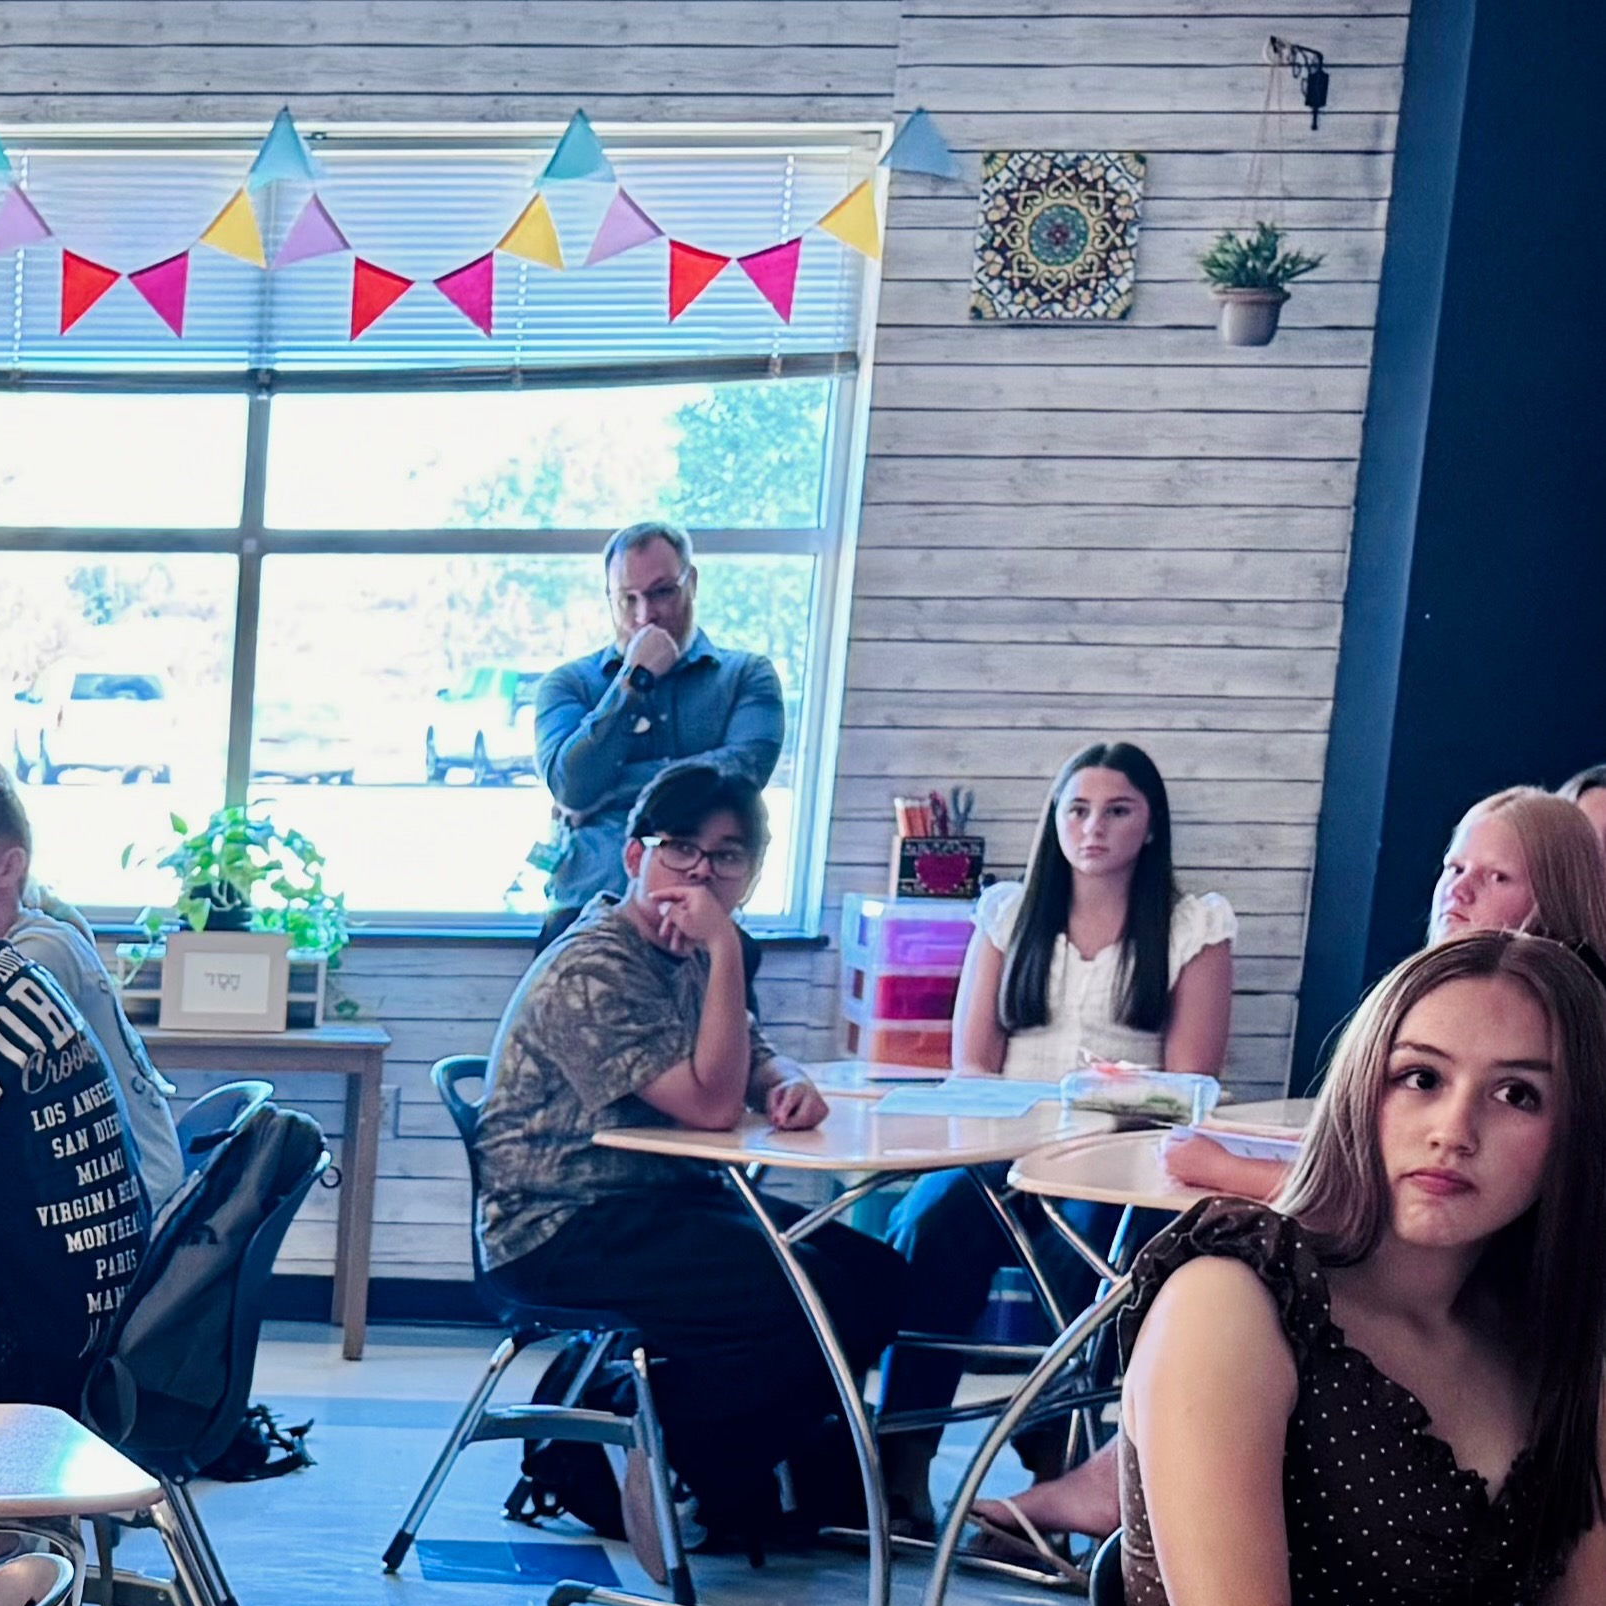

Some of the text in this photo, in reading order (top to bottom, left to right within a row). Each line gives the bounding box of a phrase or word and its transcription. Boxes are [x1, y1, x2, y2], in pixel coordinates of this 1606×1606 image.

[30, 1101, 68, 1132] LOS
[51, 1127, 90, 1160] SAN
[75, 1147, 124, 1187] MIAMI
[96, 1248, 137, 1281] PARIS
